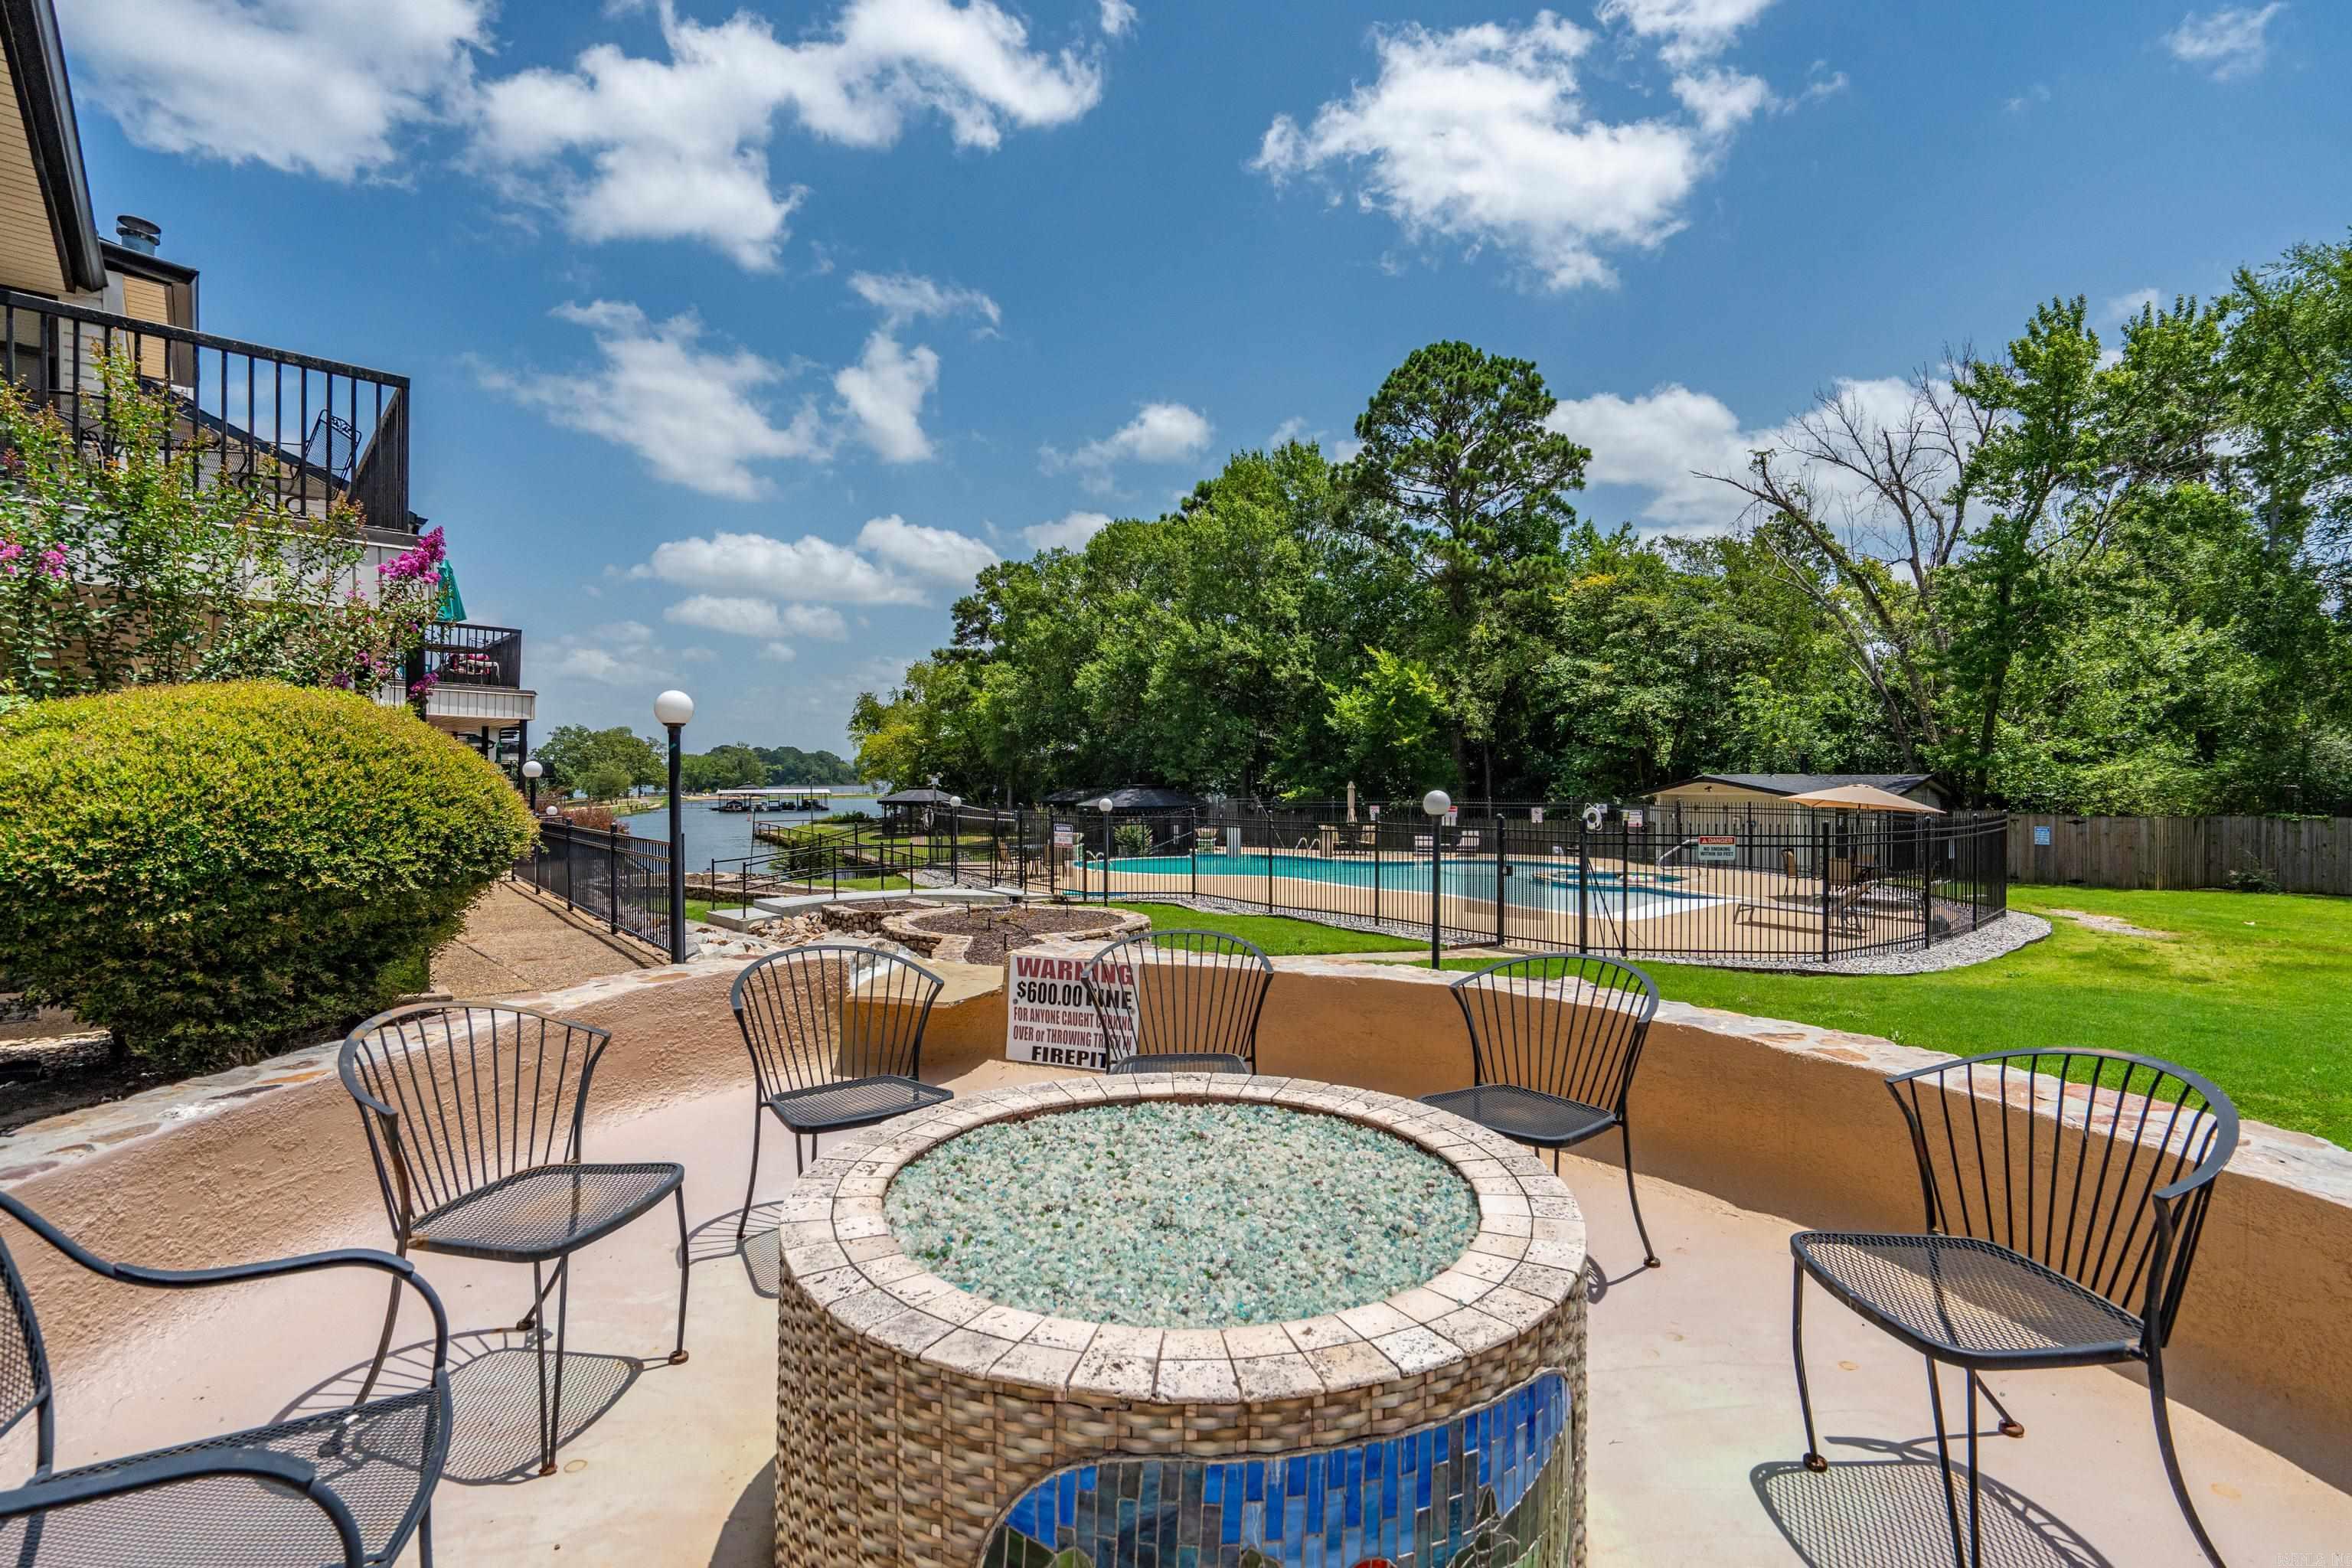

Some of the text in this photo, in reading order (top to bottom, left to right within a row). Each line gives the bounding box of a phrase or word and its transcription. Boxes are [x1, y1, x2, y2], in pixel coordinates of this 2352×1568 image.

[1016, 957, 1134, 985] WARNING
[1017, 980, 1083, 1008] $600.00
[1014, 1007, 1028, 1021] FOR
[1030, 1008, 1060, 1024] ANYONE
[1062, 1011, 1094, 1028] CAUGHT
[1013, 1025, 1034, 1041] OVER
[1036, 1030, 1044, 1042] or
[1047, 1028, 1092, 1047] THROWING
[1031, 1046, 1107, 1068] FIREPIT
